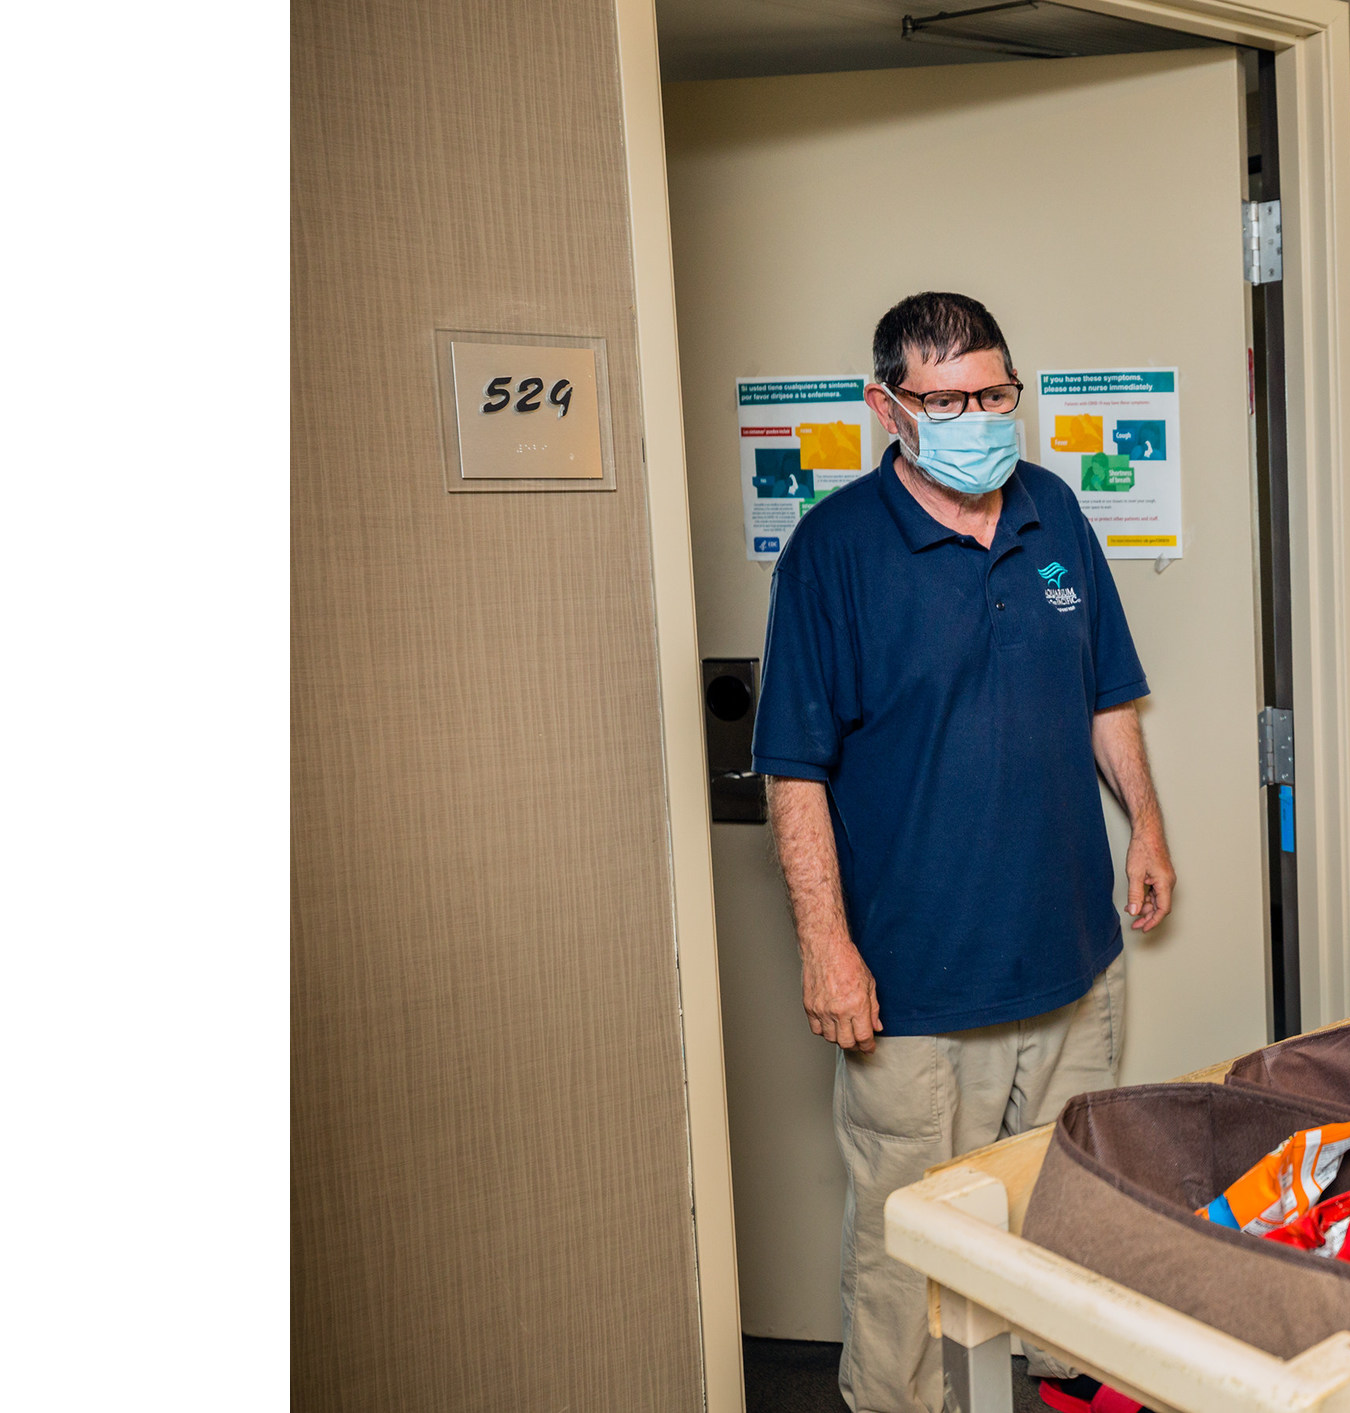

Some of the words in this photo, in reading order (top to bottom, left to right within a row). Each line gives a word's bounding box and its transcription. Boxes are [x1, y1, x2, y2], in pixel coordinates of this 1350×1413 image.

[1043, 375, 1049, 383] If
[1050, 377, 1064, 385] you
[1065, 375, 1081, 383] have
[749, 384, 766, 392] usted
[768, 383, 783, 391] tiene
[784, 383, 818, 391] cualquiera
[1043, 385, 1067, 394] please
[1109, 383, 1153, 392] immediately
[481, 376, 574, 418] 529
[1115, 431, 1132, 440] Cough
[1054, 438, 1068, 446] Fever
[1109, 469, 1132, 477] Shortness
